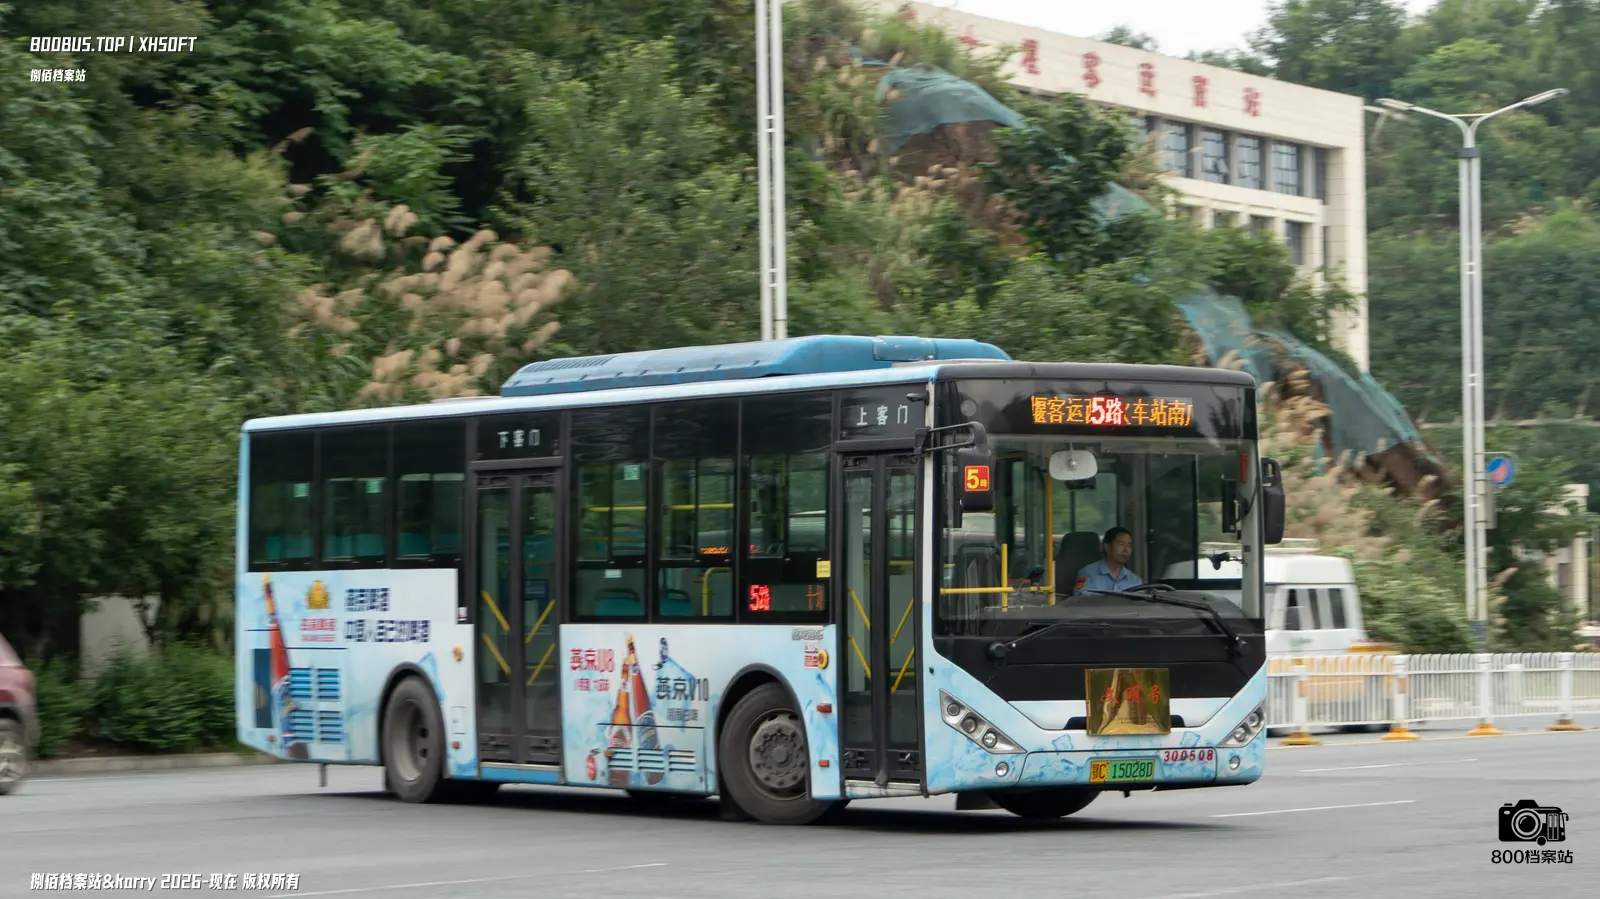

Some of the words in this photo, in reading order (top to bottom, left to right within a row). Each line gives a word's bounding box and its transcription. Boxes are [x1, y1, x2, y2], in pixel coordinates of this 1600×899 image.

[856, 404, 908, 426] 上客门
[497, 428, 540, 449] 下客门
[1163, 749, 1214, 762] 300508
